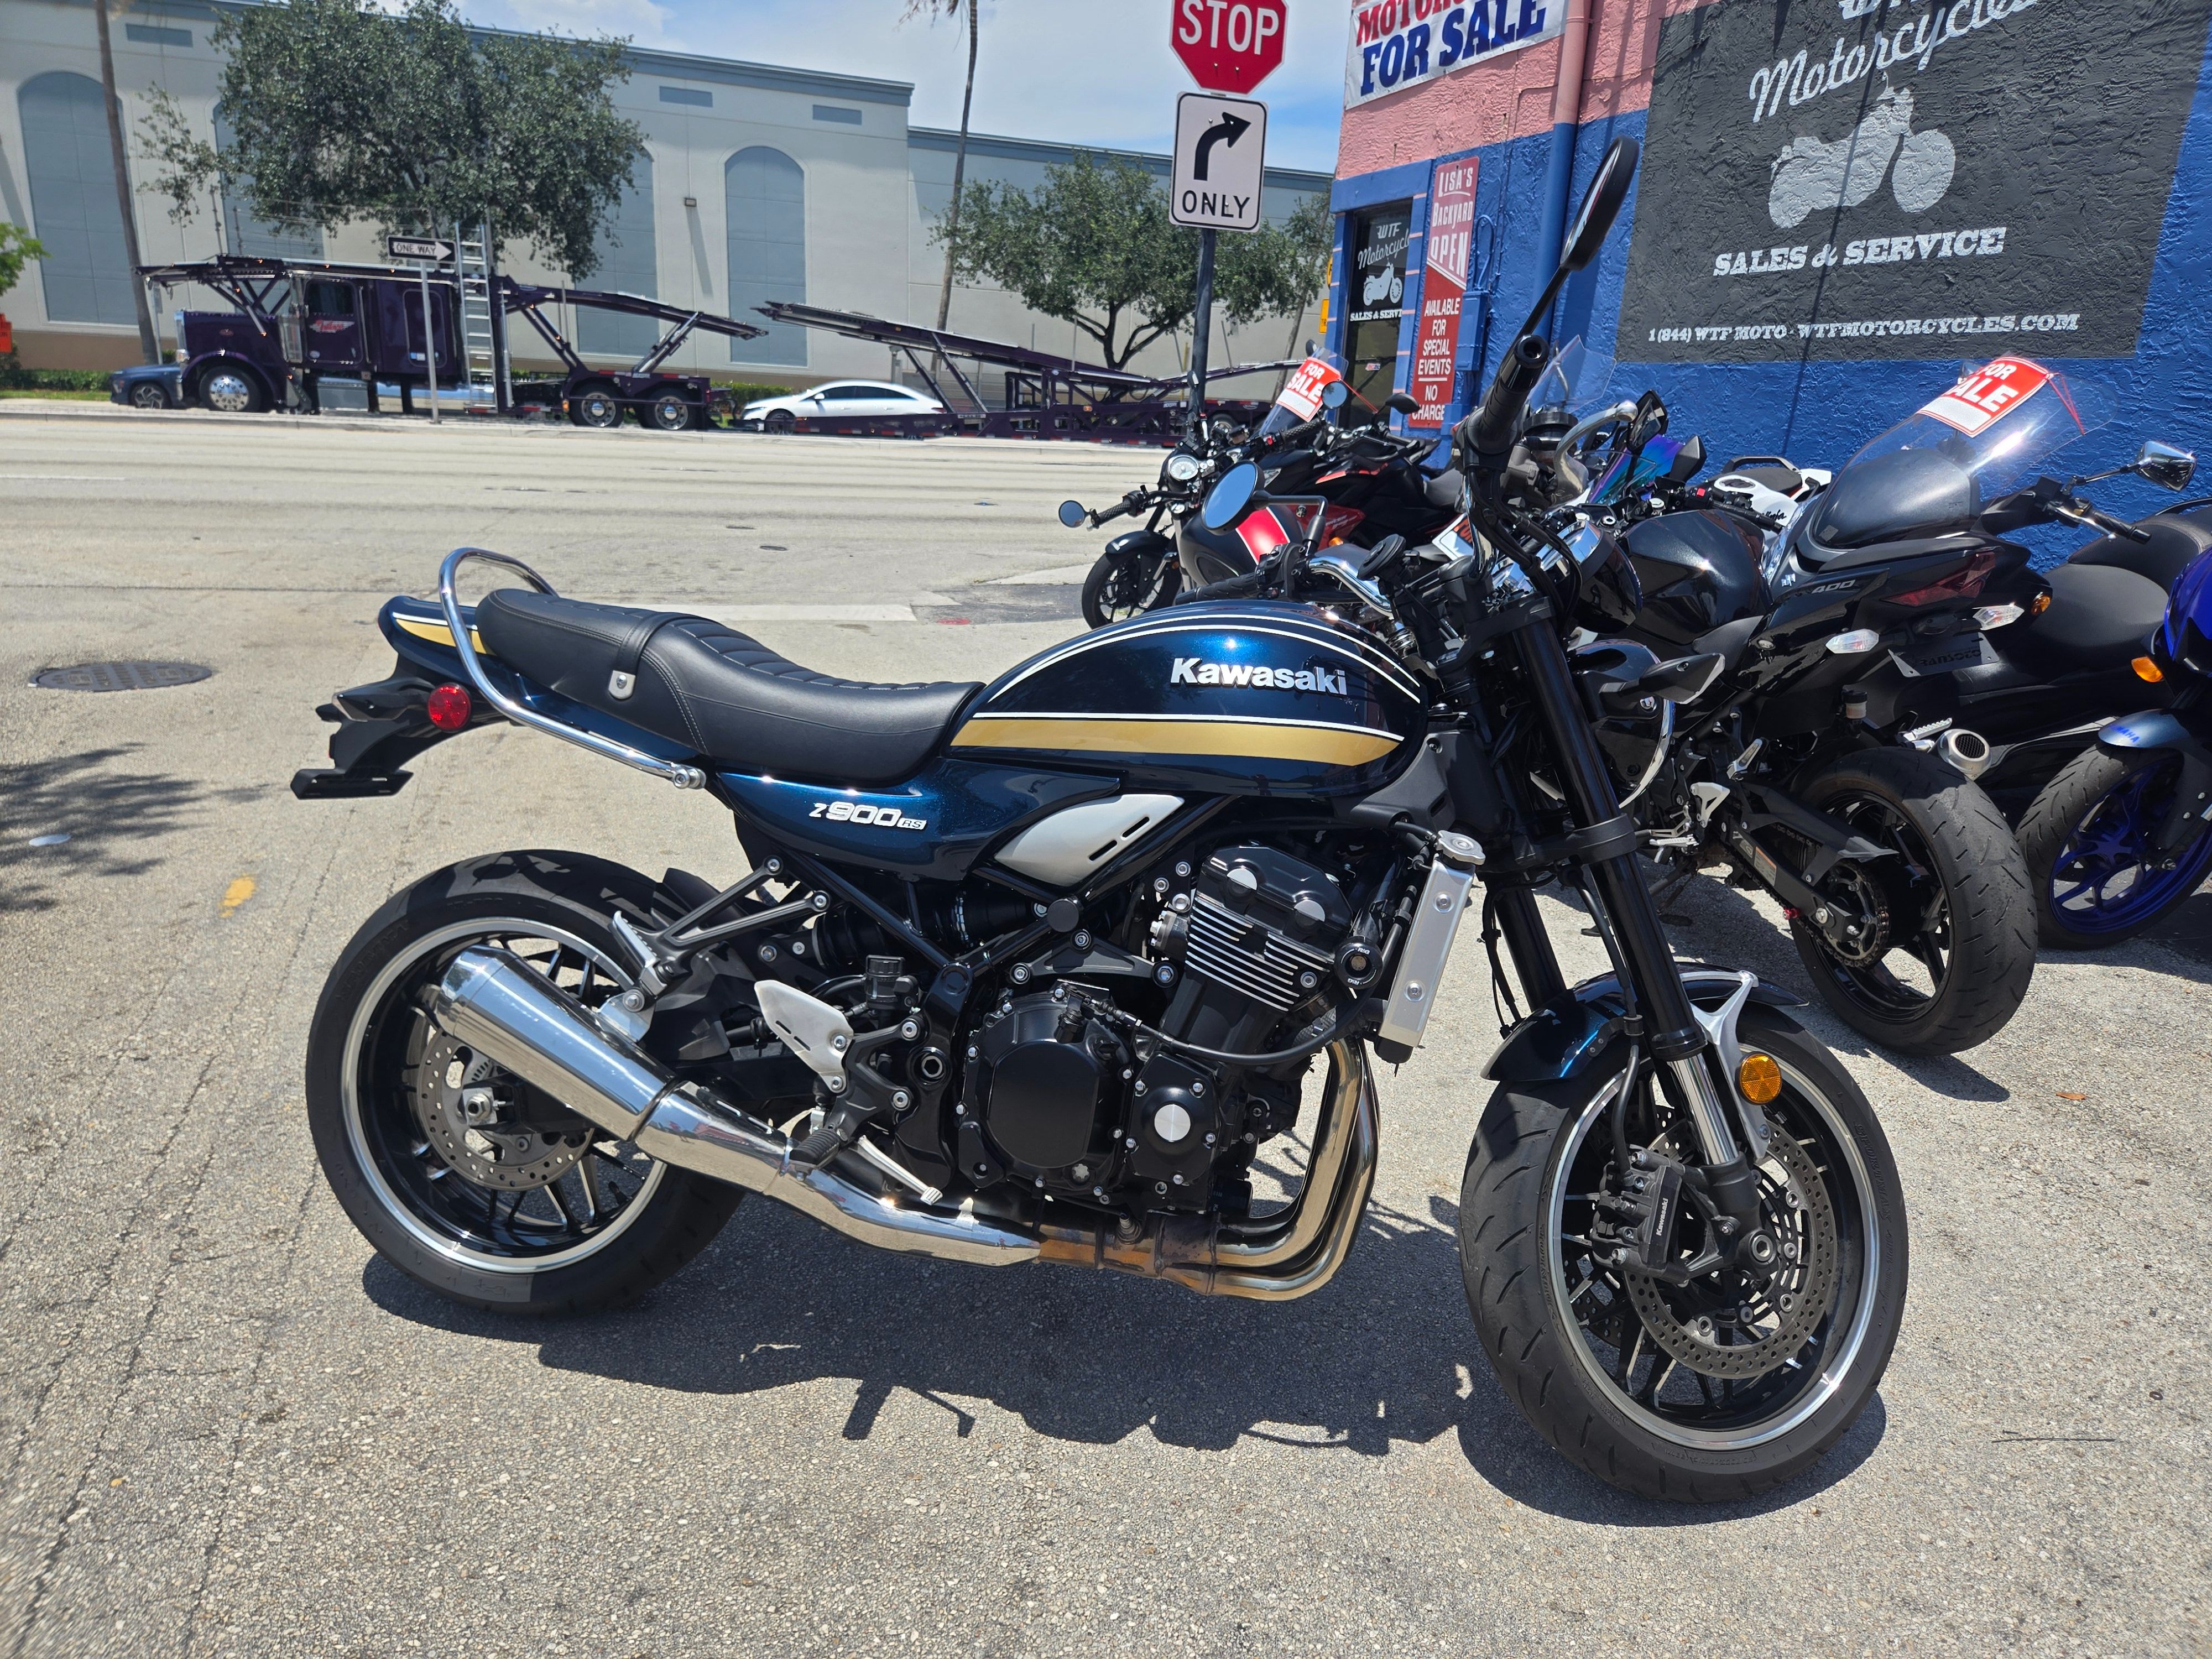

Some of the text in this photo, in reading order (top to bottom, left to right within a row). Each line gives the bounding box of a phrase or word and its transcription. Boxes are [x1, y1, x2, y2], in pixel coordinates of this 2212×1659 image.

[1179, 0, 1279, 55] STOP
[1360, 0, 1546, 96] FOR SALE
[1182, 190, 1250, 219] ONLY
[1376, 222, 1402, 239] WTF
[397, 243, 436, 255] ONE WAY
[1431, 231, 1468, 278] OPEN
[1713, 227, 2007, 275] SALES & SERVICE
[1350, 311, 1373, 321] SALES
[1373, 311, 1379, 320] &
[1425, 298, 1460, 317] AVAILABLE
[1432, 319, 1447, 336] FOR
[1648, 328, 1656, 341] 1
[1657, 327, 1692, 343] (844)
[1694, 327, 1732, 341] WTF
[1733, 325, 1787, 341] MOTO
[1797, 314, 2080, 339] WTFMOTORCYCLES.COM
[1422, 338, 1451, 356] SPECIAL
[1305, 363, 1325, 380] FOR
[1418, 358, 1451, 375] EVENTS
[1976, 363, 2017, 380] FOR
[1287, 373, 1323, 403] SALE
[1425, 384, 1438, 401] NO
[1946, 376, 2019, 413] ALE
[1811, 580, 1856, 594] 400
[1171, 658, 1348, 696] Kawasaki
[1656, 1197, 1668, 1237] Kawasaki
